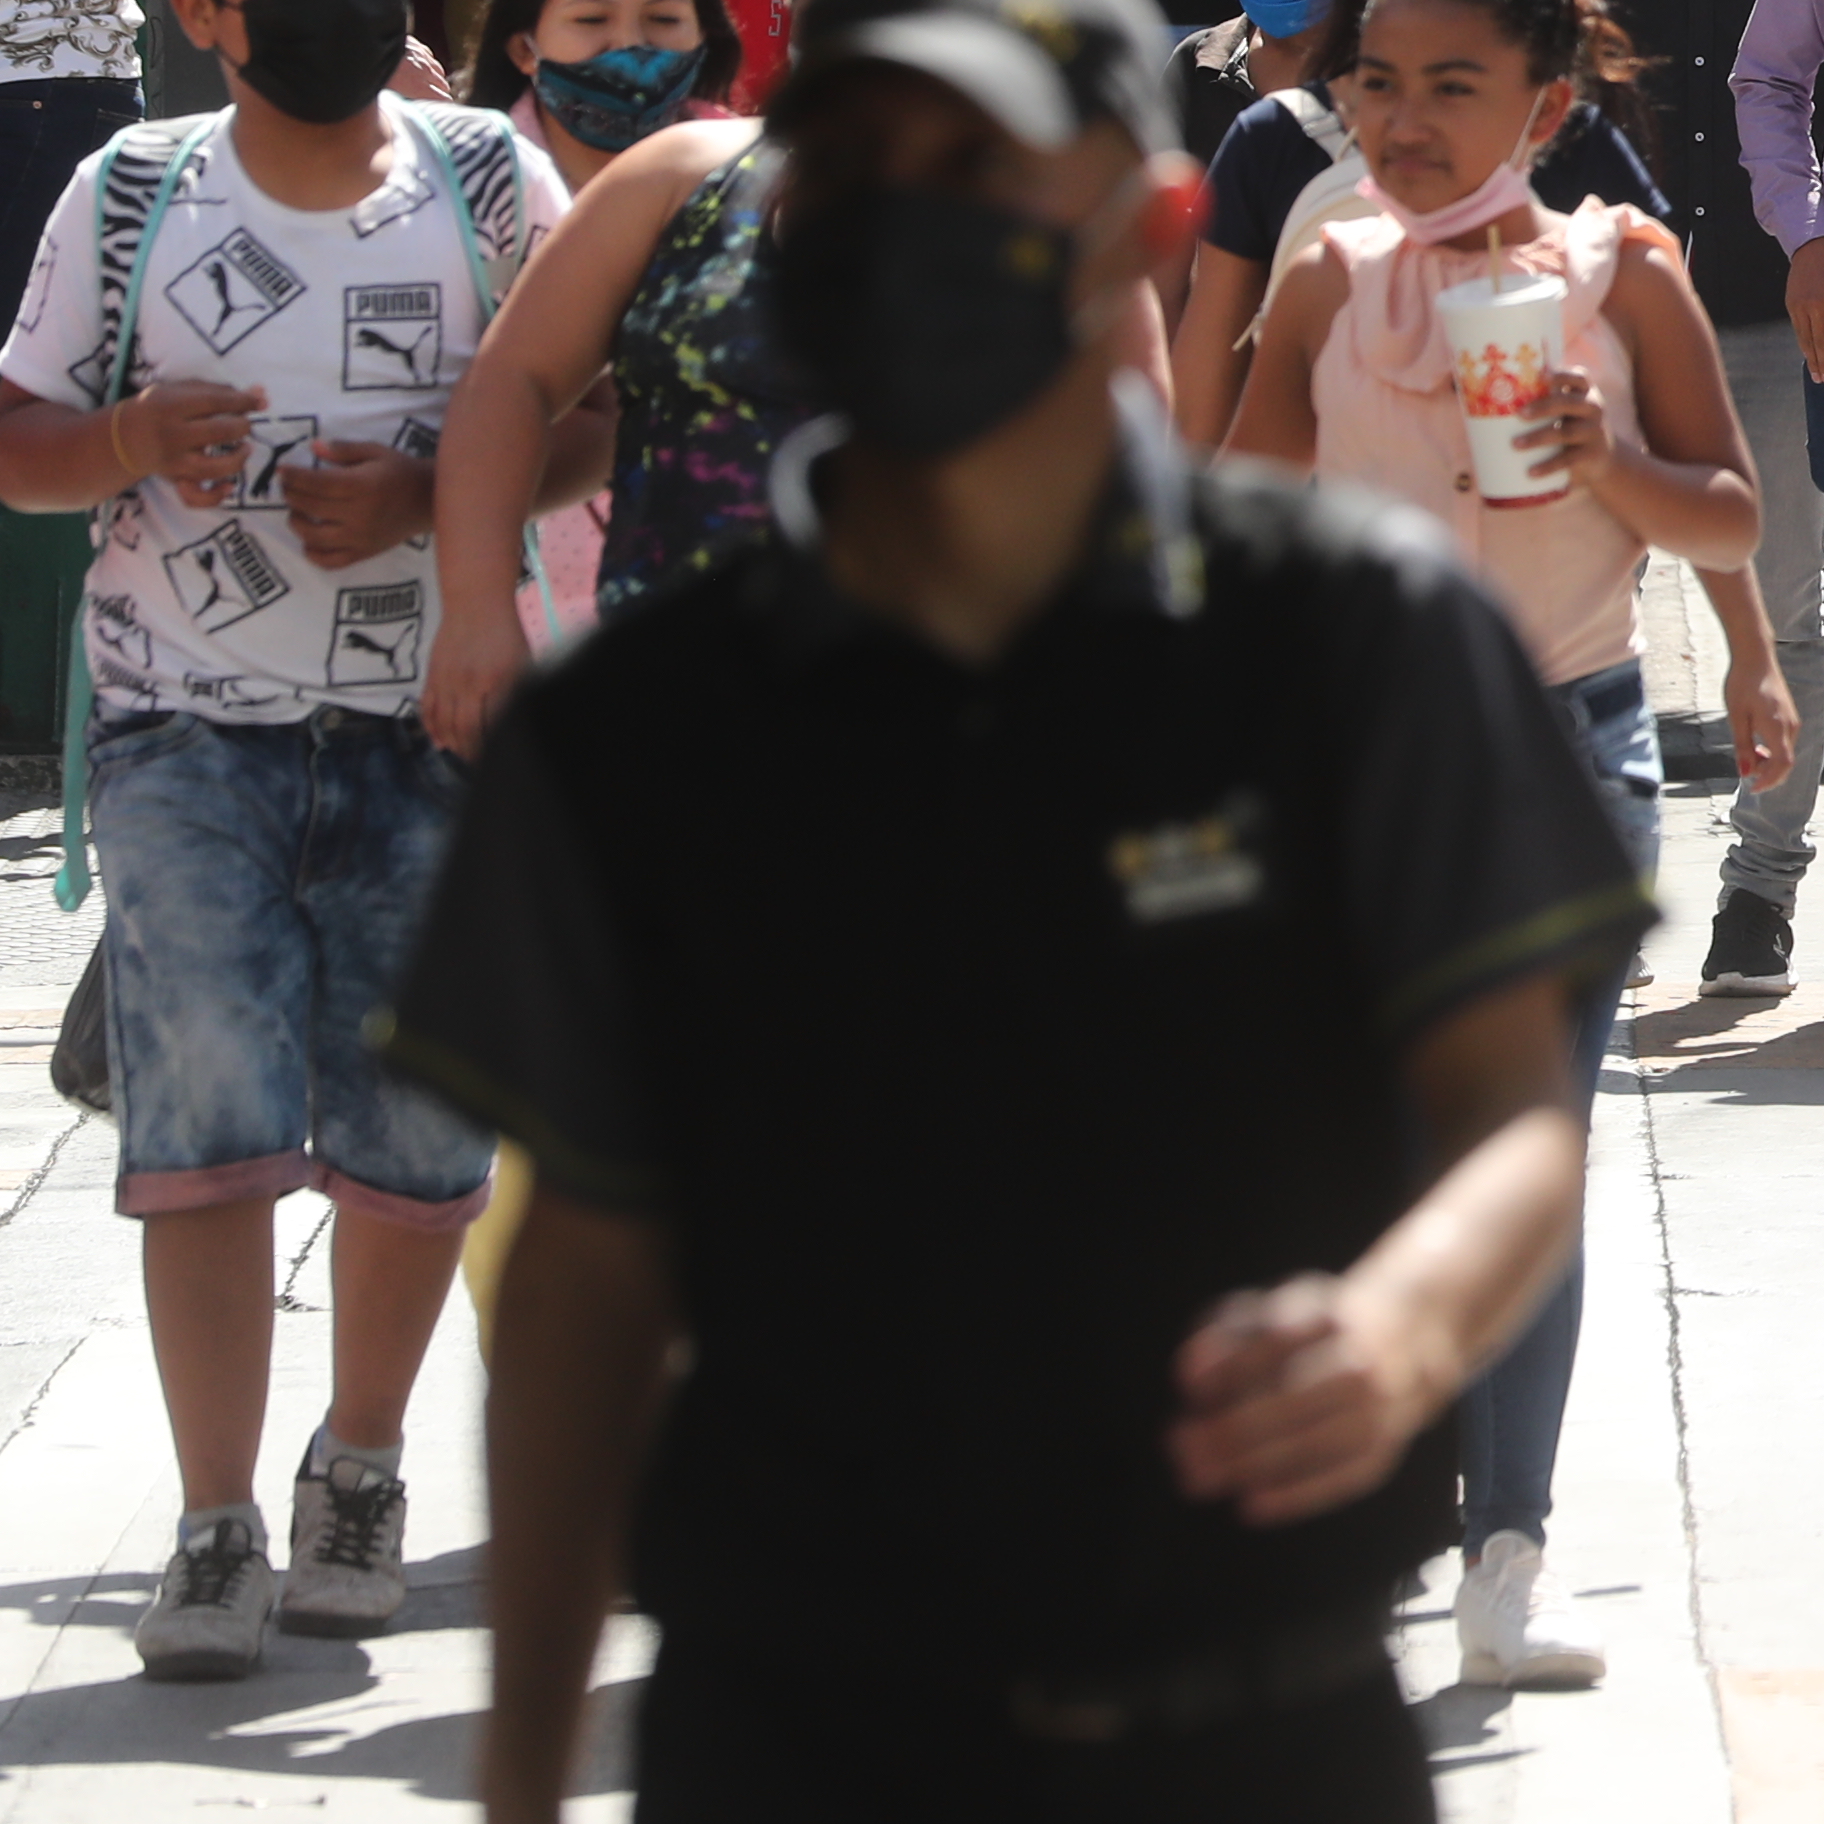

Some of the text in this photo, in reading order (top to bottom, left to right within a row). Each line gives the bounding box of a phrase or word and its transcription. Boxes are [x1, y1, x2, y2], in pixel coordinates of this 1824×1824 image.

[231, 236, 295, 298] PUMA
[356, 290, 431, 315] PUMA
[216, 527, 277, 597] PUMA
[349, 589, 418, 618] PUMA
